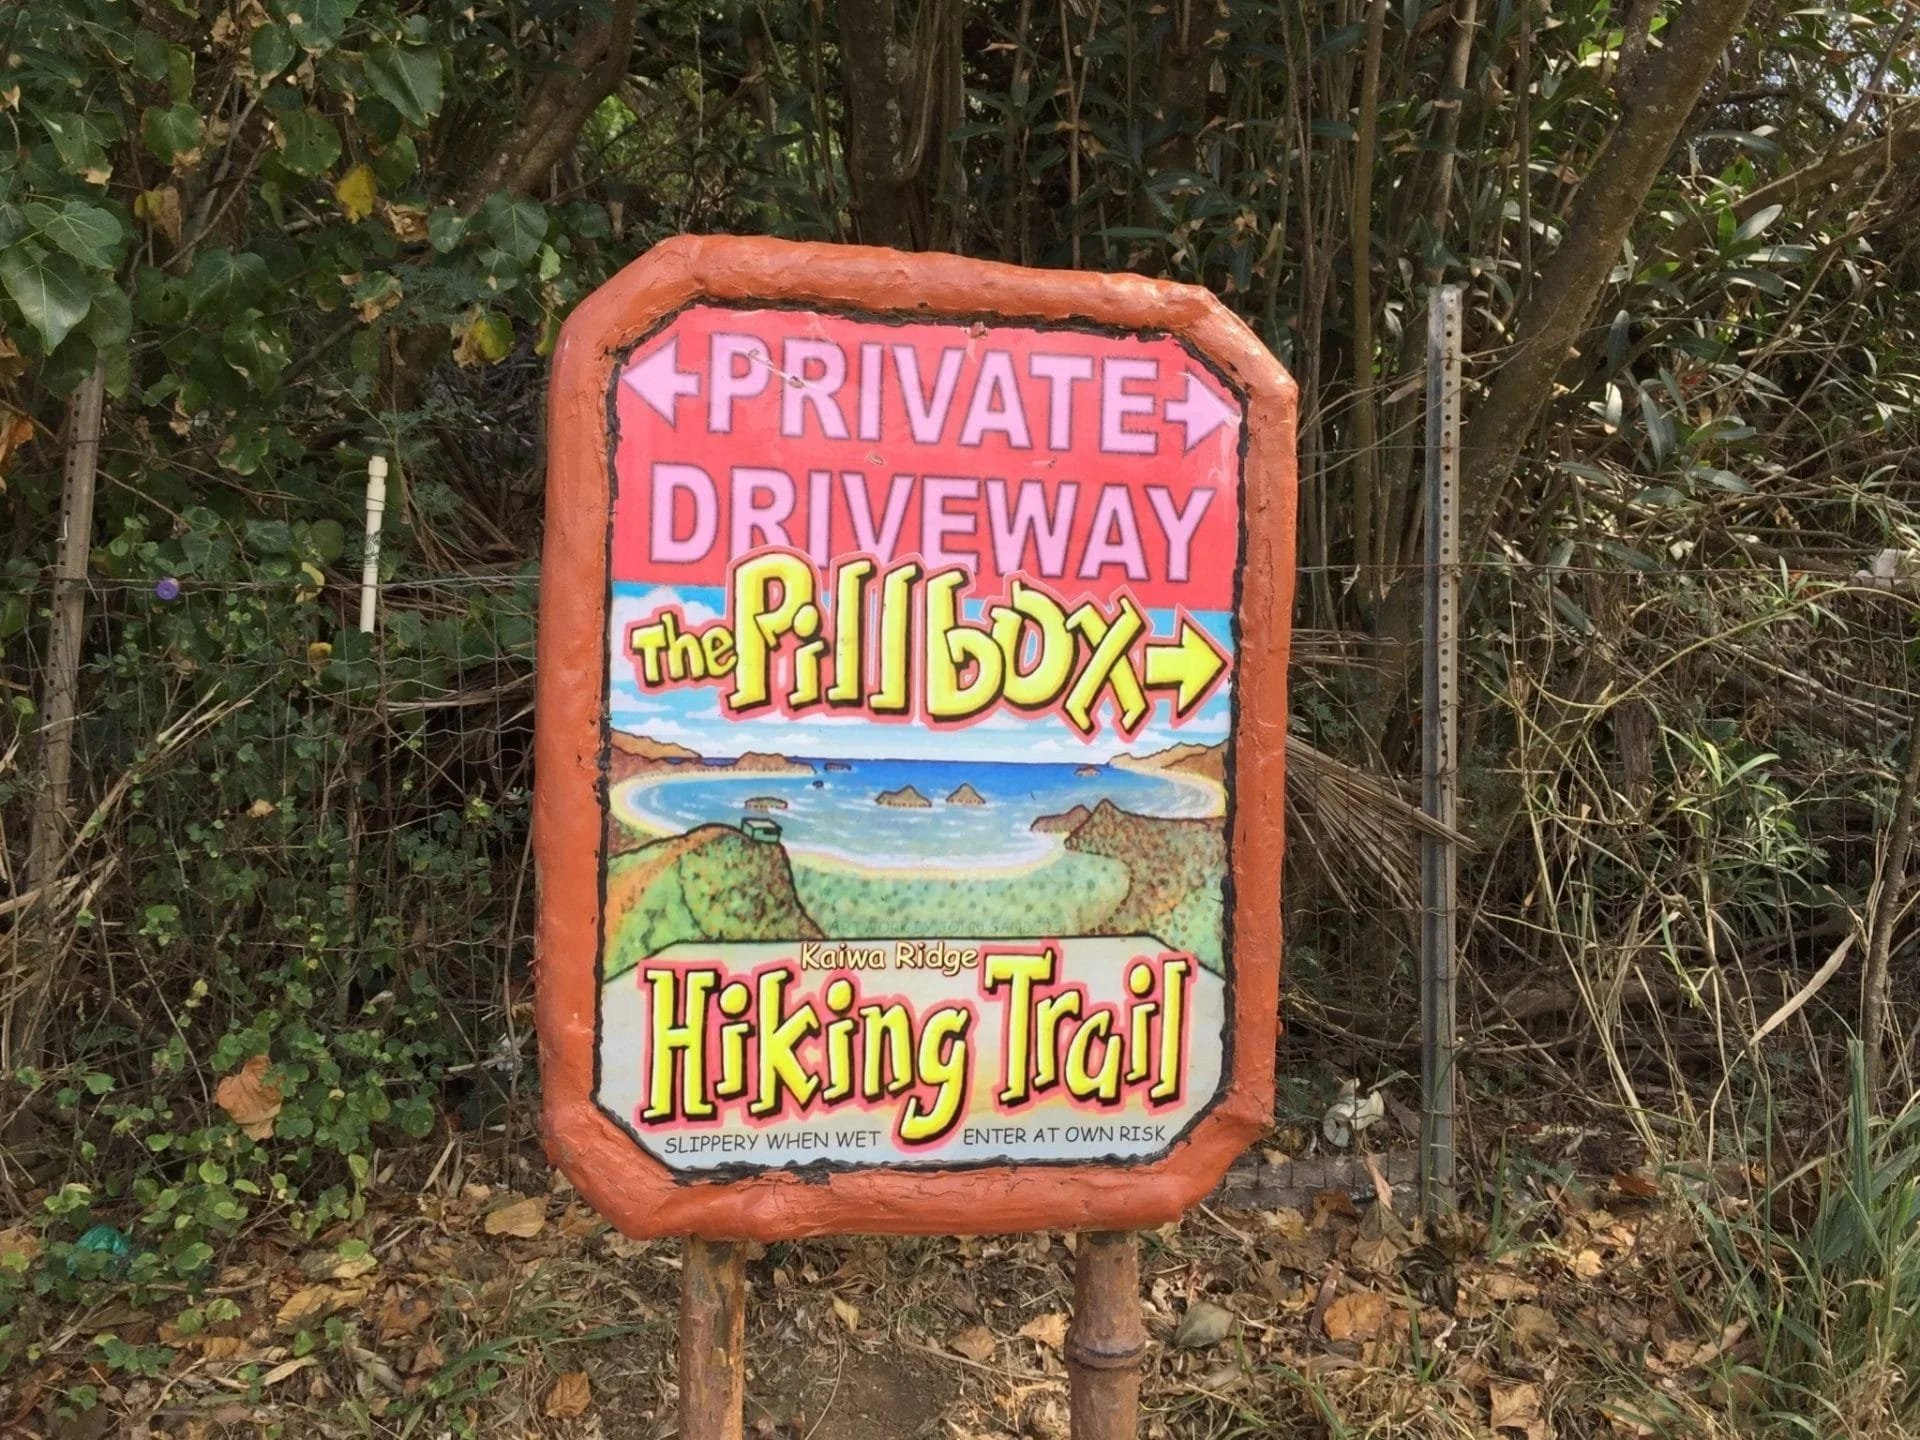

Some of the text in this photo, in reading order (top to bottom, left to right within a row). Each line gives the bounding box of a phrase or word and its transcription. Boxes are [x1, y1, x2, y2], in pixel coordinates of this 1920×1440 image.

[707, 332, 1159, 454] PRIVATE
[649, 462, 1217, 583] DRIVEWAY
[631, 552, 1149, 733] The Pillbox
[801, 941, 979, 977] Kaiwa Ridge
[641, 948, 1190, 1146] Hiking Trail
[664, 1130, 882, 1154] SLIPPERY WHEN WET
[963, 1125, 1166, 1145] ENTER AT OWN RISK
